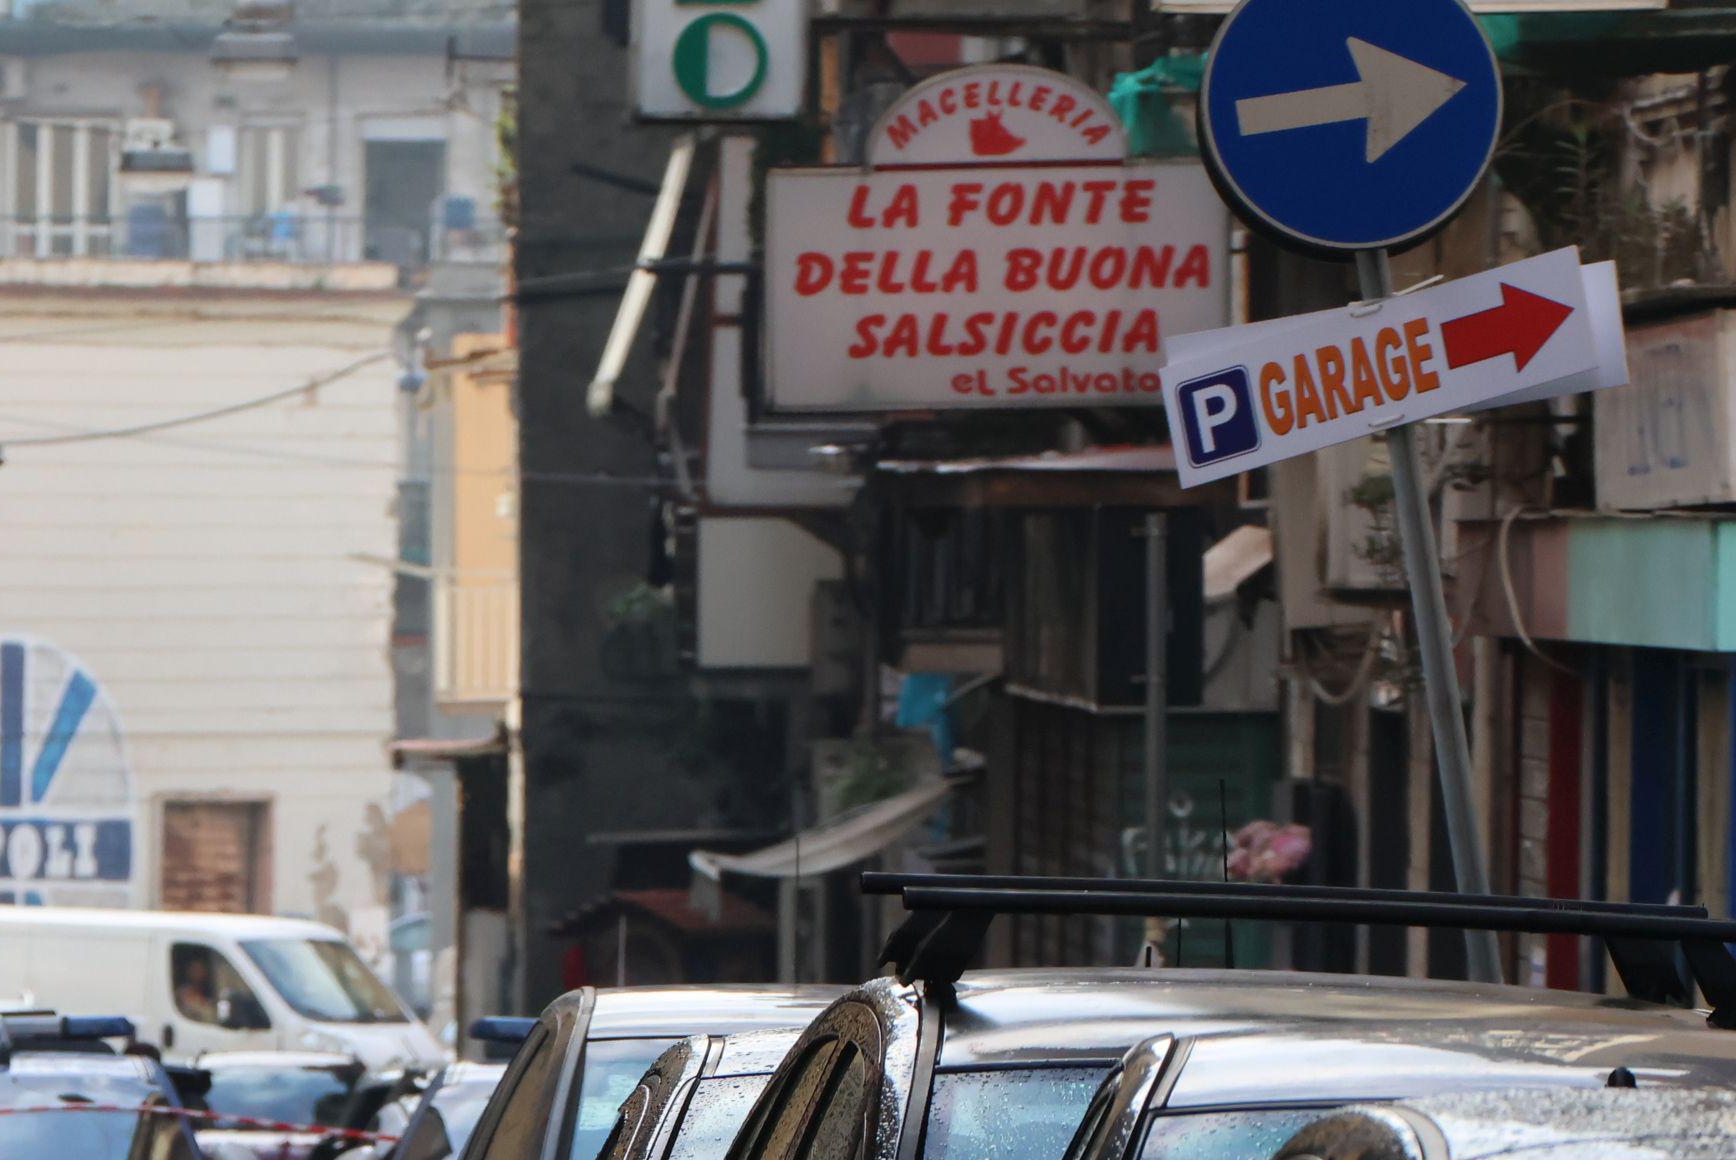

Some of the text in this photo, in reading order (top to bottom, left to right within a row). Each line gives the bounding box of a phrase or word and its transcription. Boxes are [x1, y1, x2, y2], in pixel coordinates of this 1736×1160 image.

[886, 80, 1111, 150] MACELLERIA
[847, 179, 1156, 229] LA FONTE
[793, 244, 1210, 297] DELLA BUONA
[847, 308, 1160, 360] SALSICCIA
[1191, 316, 1441, 454] P GARAGE
